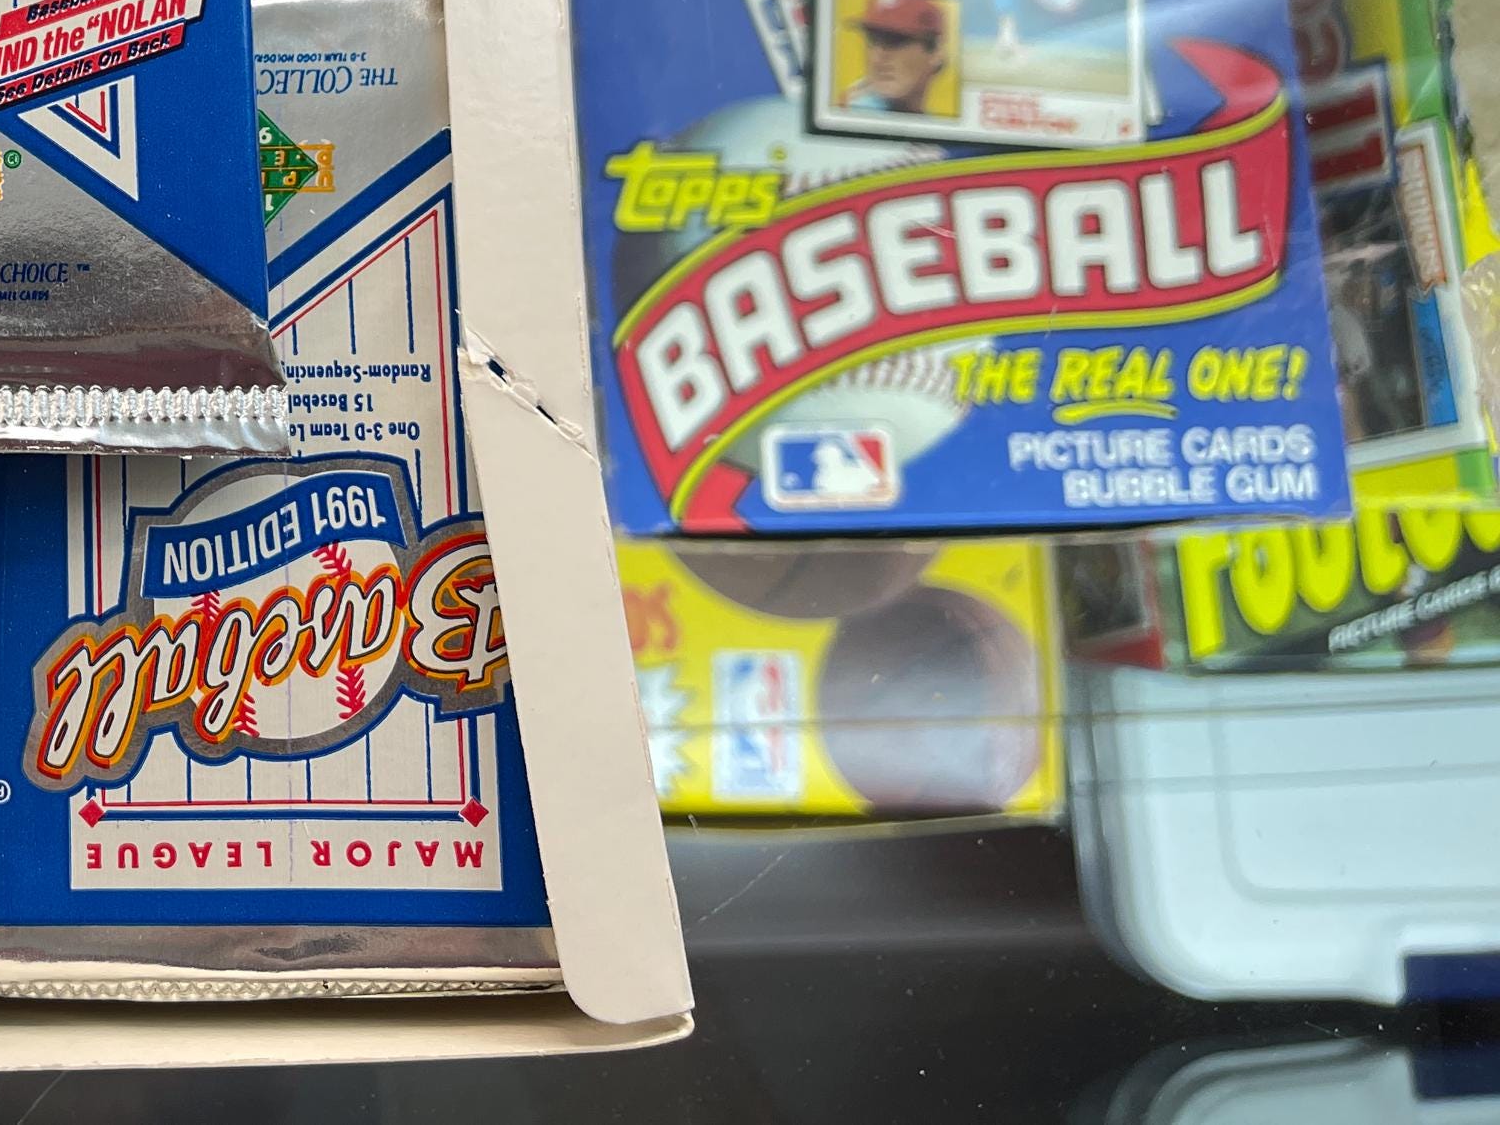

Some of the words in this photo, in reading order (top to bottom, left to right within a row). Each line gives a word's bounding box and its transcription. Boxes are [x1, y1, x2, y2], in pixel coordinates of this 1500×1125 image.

[42, 24, 84, 62] the
[33, 61, 94, 94] Details
[99, 52, 122, 70] On
[127, 30, 172, 60] Back
[359, 68, 398, 86] THE
[0, 262, 69, 283] CHOICE
[18, 290, 49, 302] CARDS
[636, 159, 1263, 454] BASEBALL
[948, 349, 1041, 404] THE
[1049, 345, 1176, 403] REAL
[1188, 344, 1309, 403] ONE!
[354, 394, 373, 411] 15
[309, 421, 349, 440] Team
[355, 422, 382, 440] 3-D
[389, 422, 420, 440] One
[1007, 428, 1175, 471] PICTURE
[1181, 424, 1317, 465] CARDS
[1062, 466, 1218, 508] BUBBLE
[1225, 463, 1318, 504] GUM
[312, 486, 387, 535] 1991
[163, 500, 301, 585] EDITION
[37, 533, 508, 779] Baseball
[86, 841, 272, 868] LEAGUE
[311, 840, 483, 868] MAJOR
